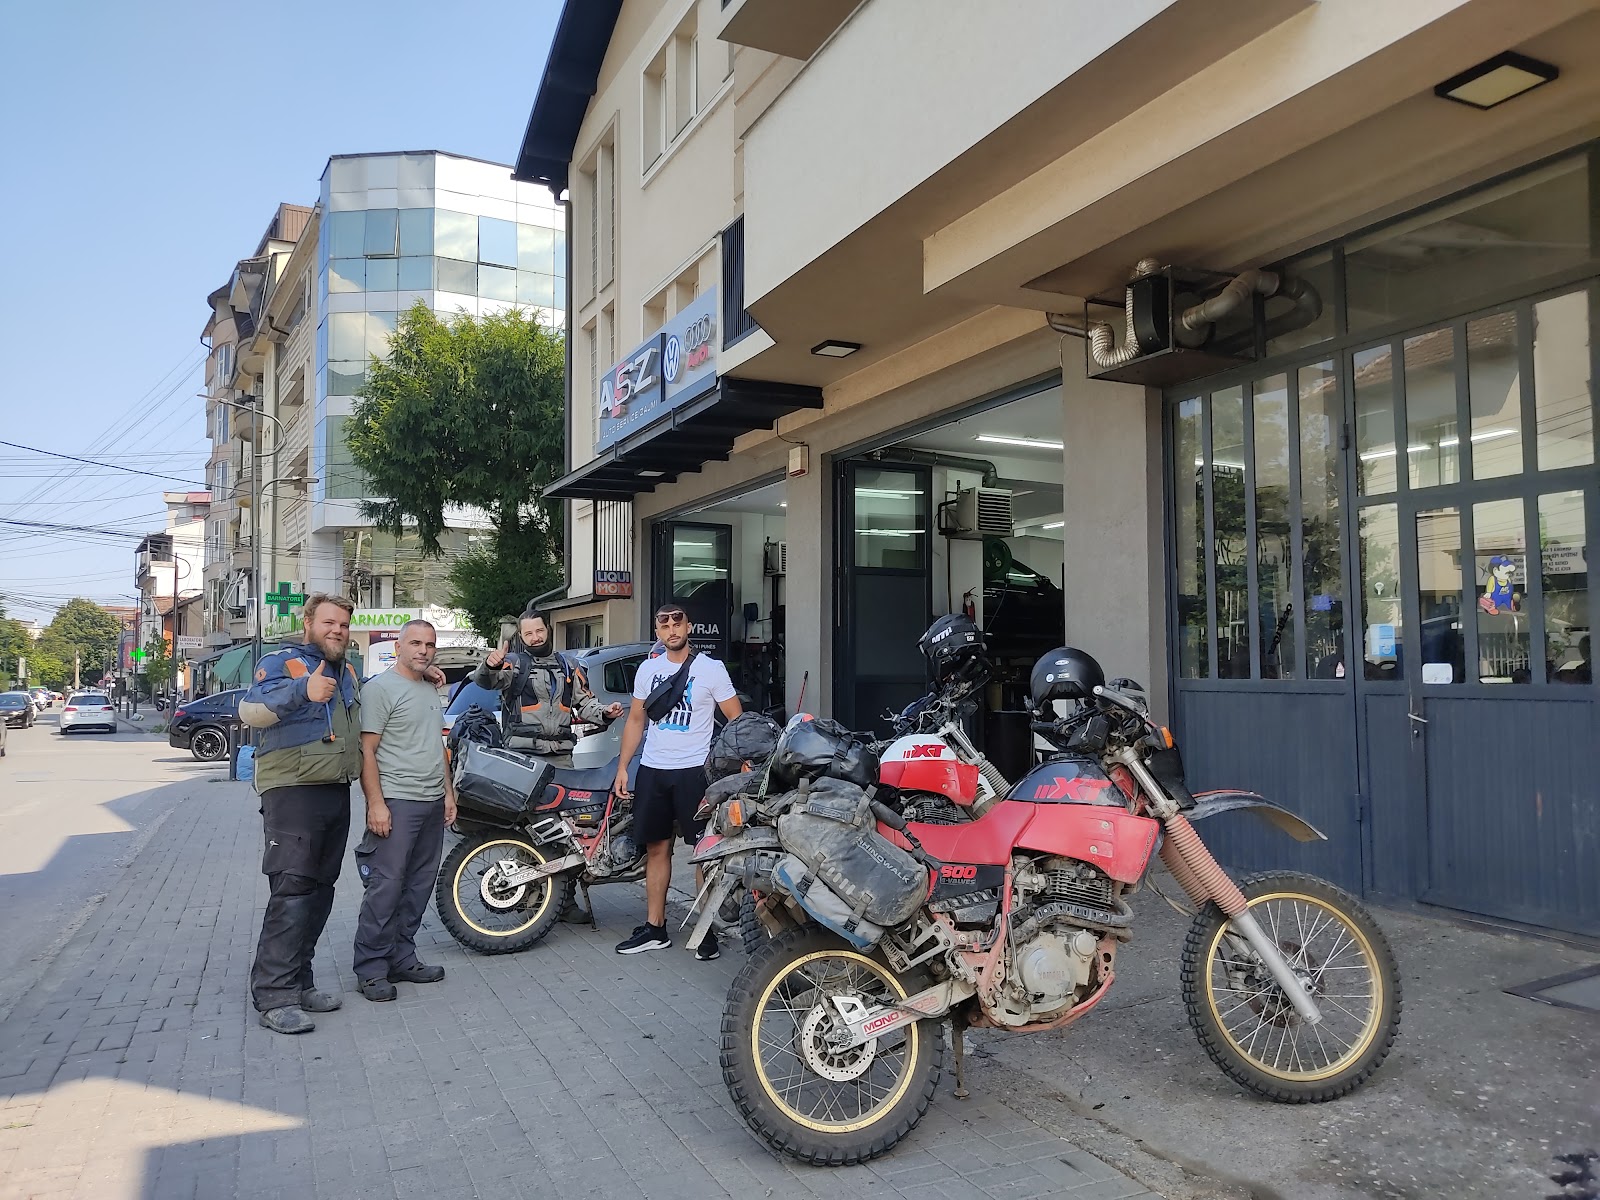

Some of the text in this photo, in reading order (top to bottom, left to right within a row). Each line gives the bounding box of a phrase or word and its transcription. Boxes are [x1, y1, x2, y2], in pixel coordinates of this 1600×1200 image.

[597, 571, 630, 583] LIQUI
[597, 583, 631, 594] MOLY
[350, 613, 411, 626] ARNATOR
[691, 623, 720, 635] YRJA
[855, 836, 910, 883] RHINOWALK
[863, 1011, 900, 1032] MONO
